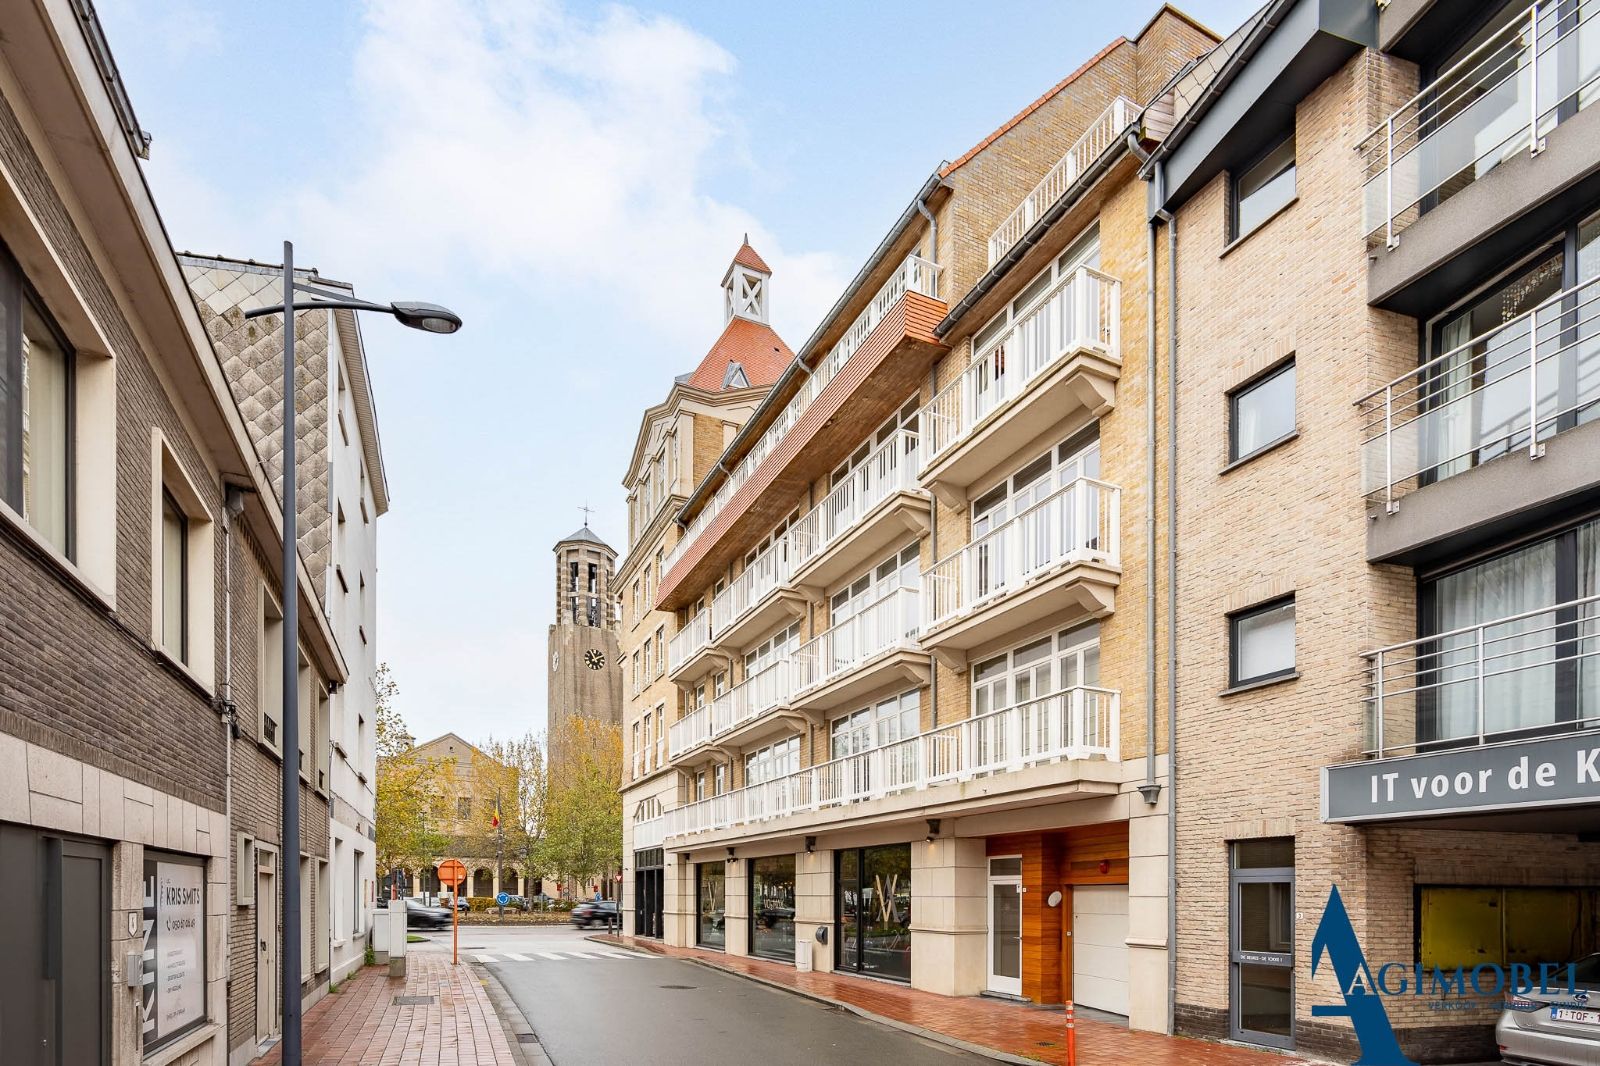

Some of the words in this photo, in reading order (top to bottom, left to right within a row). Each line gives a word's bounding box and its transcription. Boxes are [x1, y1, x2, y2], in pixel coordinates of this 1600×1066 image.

[1371, 772, 1399, 803] IT
[1410, 768, 1493, 799] voor
[1507, 756, 1557, 791] de
[1576, 749, 1600, 785] K
[166, 886, 181, 906] KRIS
[182, 887, 200, 905] SMITS
